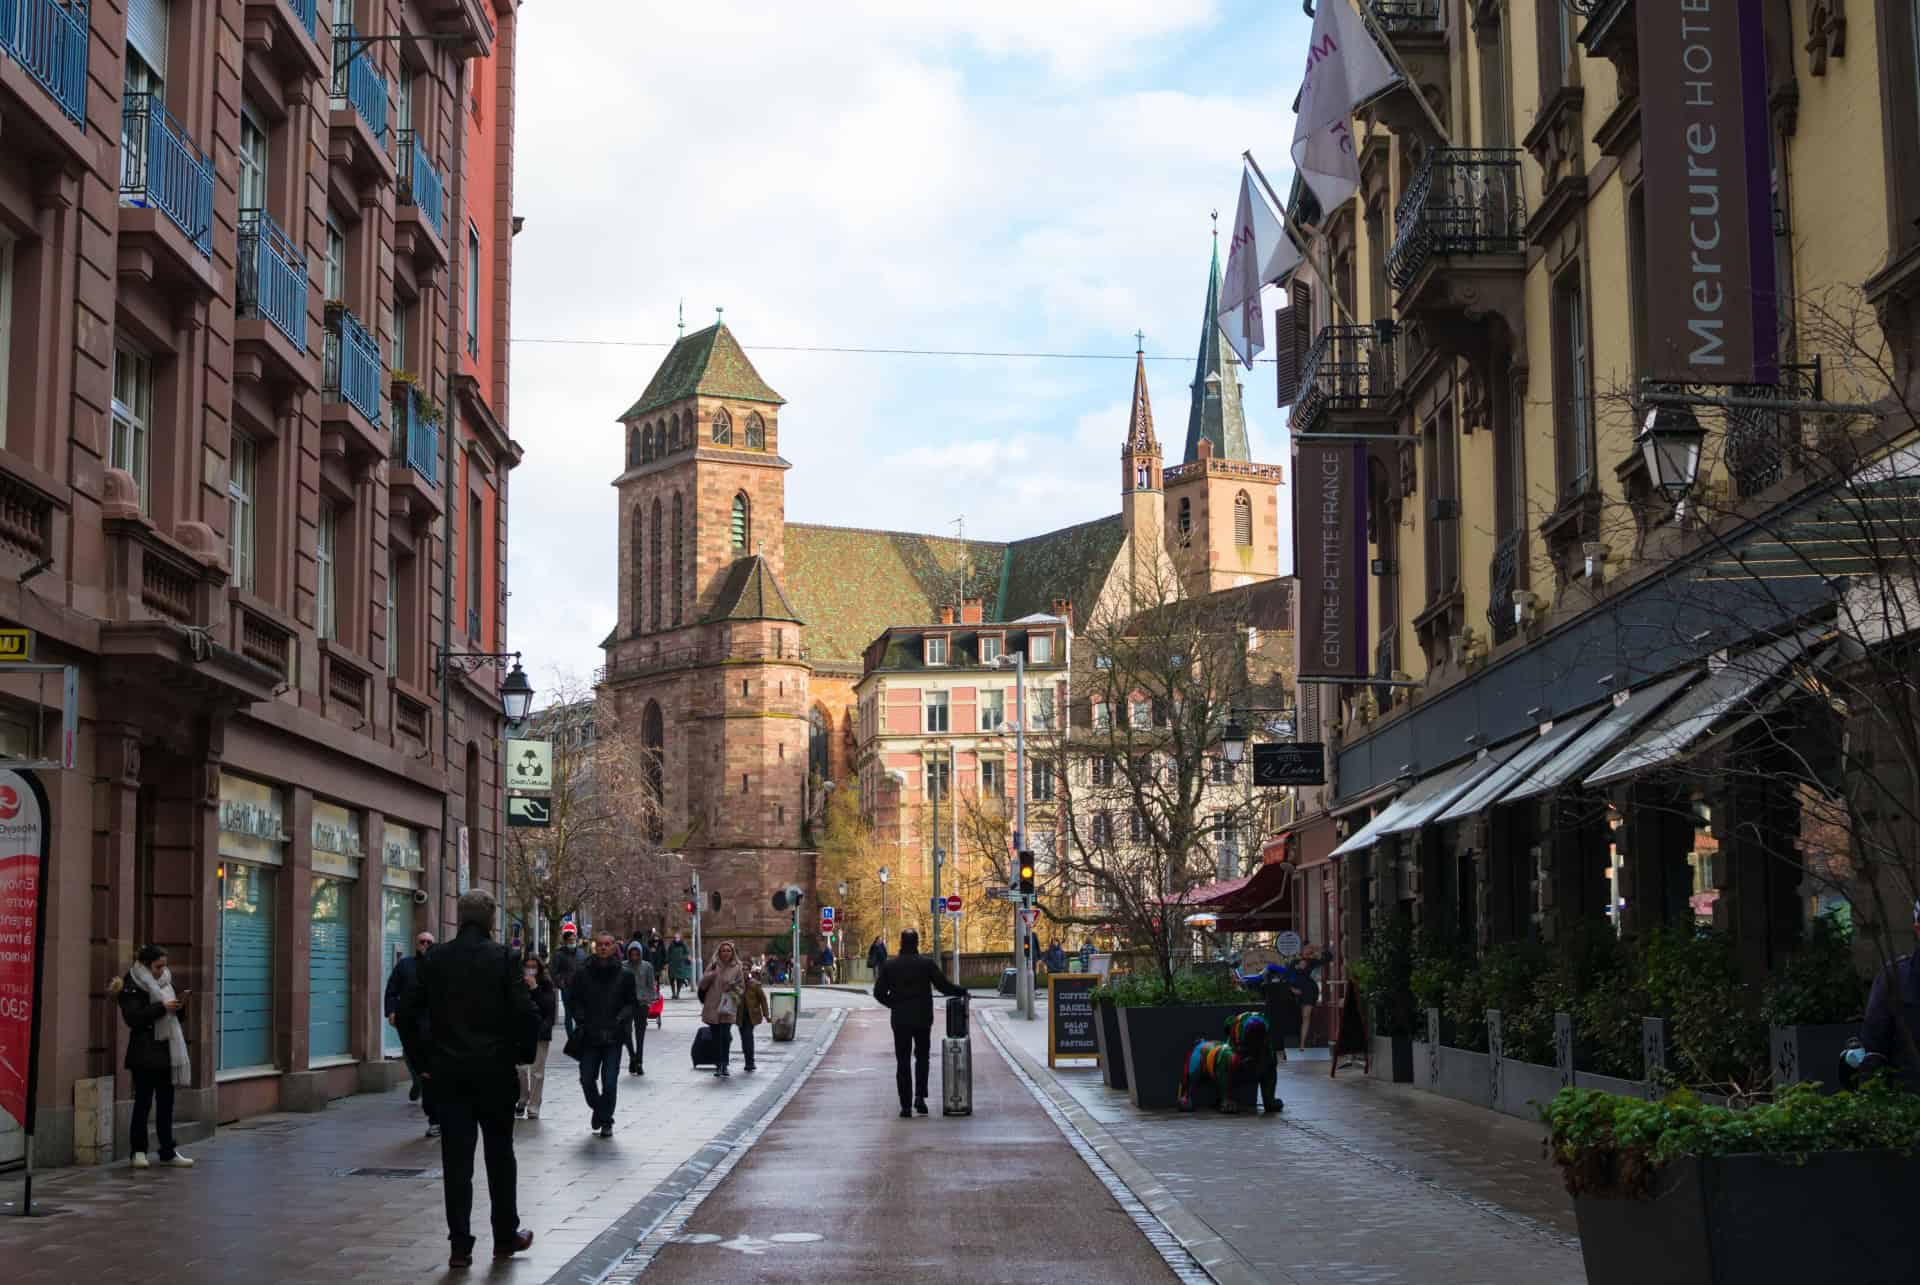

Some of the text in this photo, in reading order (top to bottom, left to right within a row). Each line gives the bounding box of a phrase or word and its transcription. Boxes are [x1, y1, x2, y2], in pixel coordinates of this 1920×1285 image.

[1687, 122, 1725, 366] Mercure
[1322, 451, 1340, 668] CENTRE PETITE FRANCE
